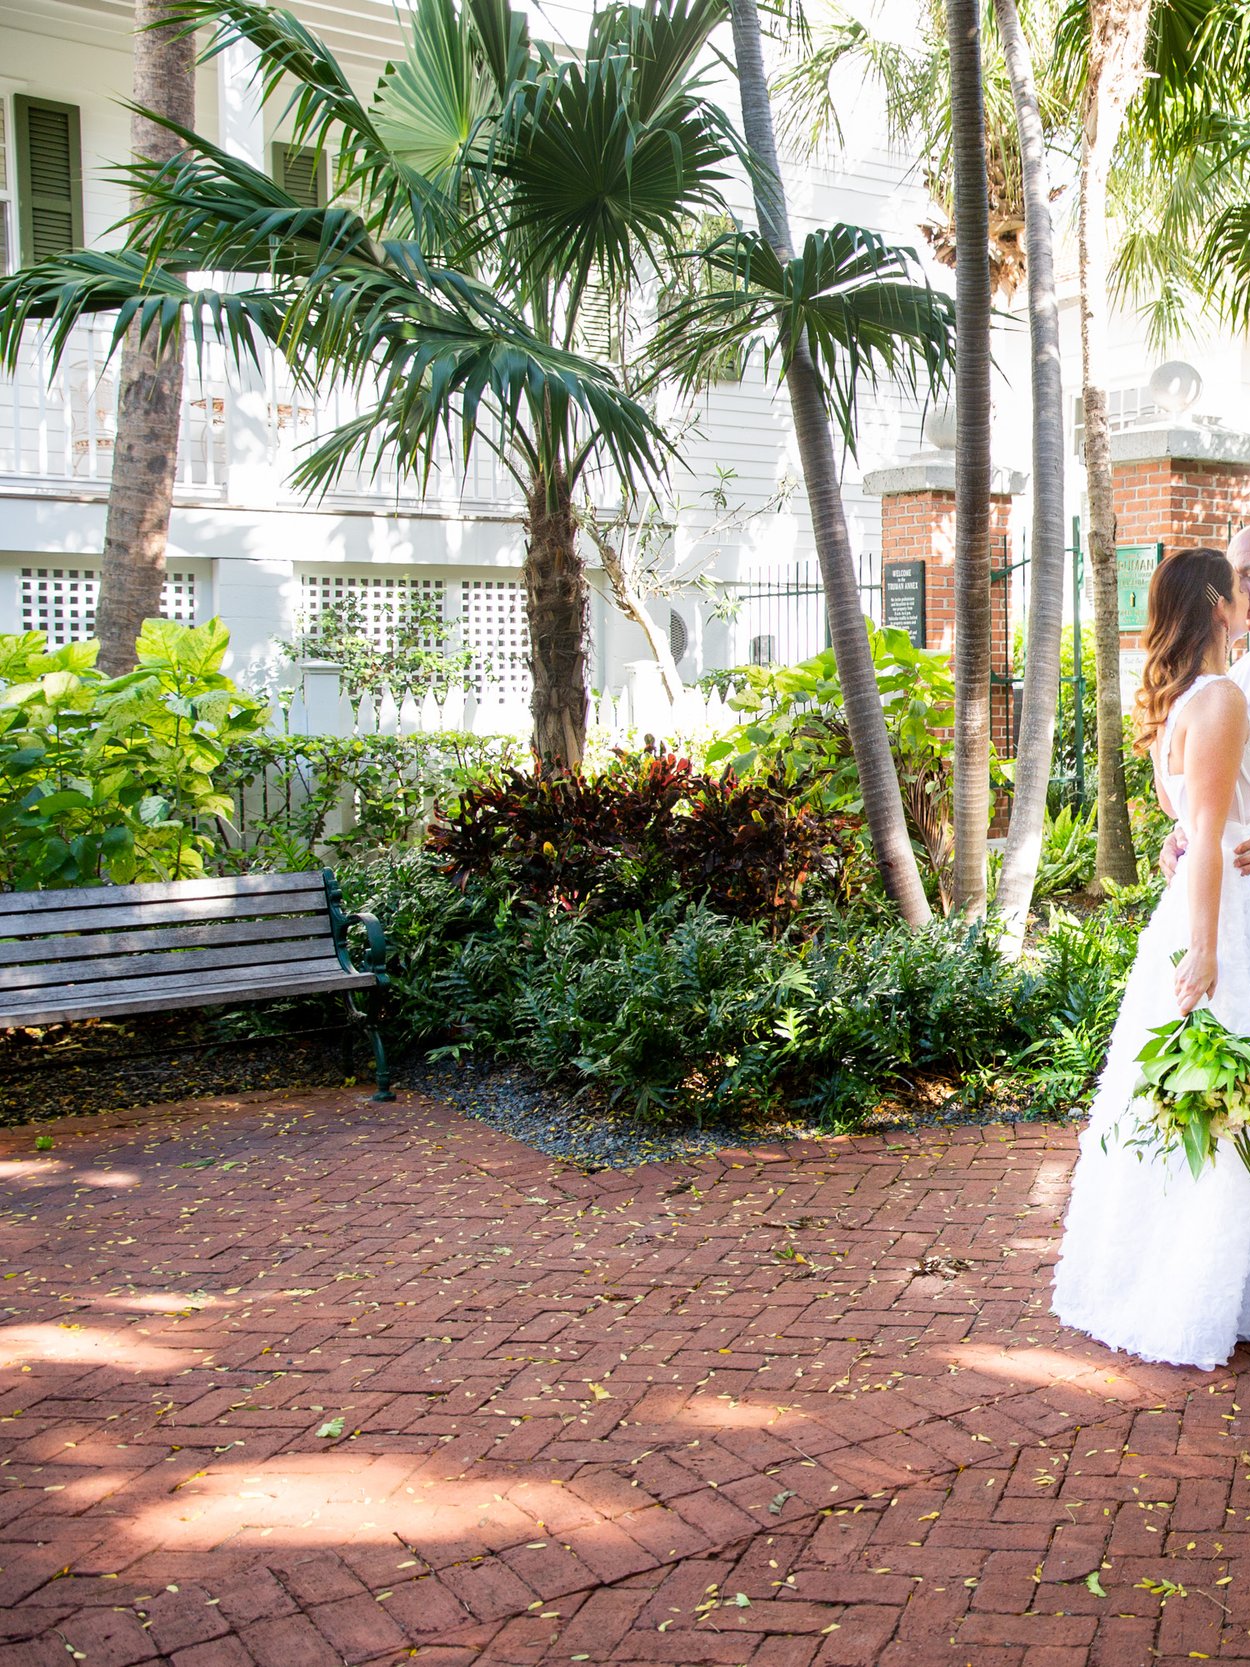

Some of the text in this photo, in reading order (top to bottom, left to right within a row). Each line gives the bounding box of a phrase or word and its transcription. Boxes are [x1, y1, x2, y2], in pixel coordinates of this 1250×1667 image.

[1117, 559, 1154, 570] RUMAN
[892, 569, 912, 577] WELCOME
[887, 581, 918, 591] TRUMAN ANNEX
